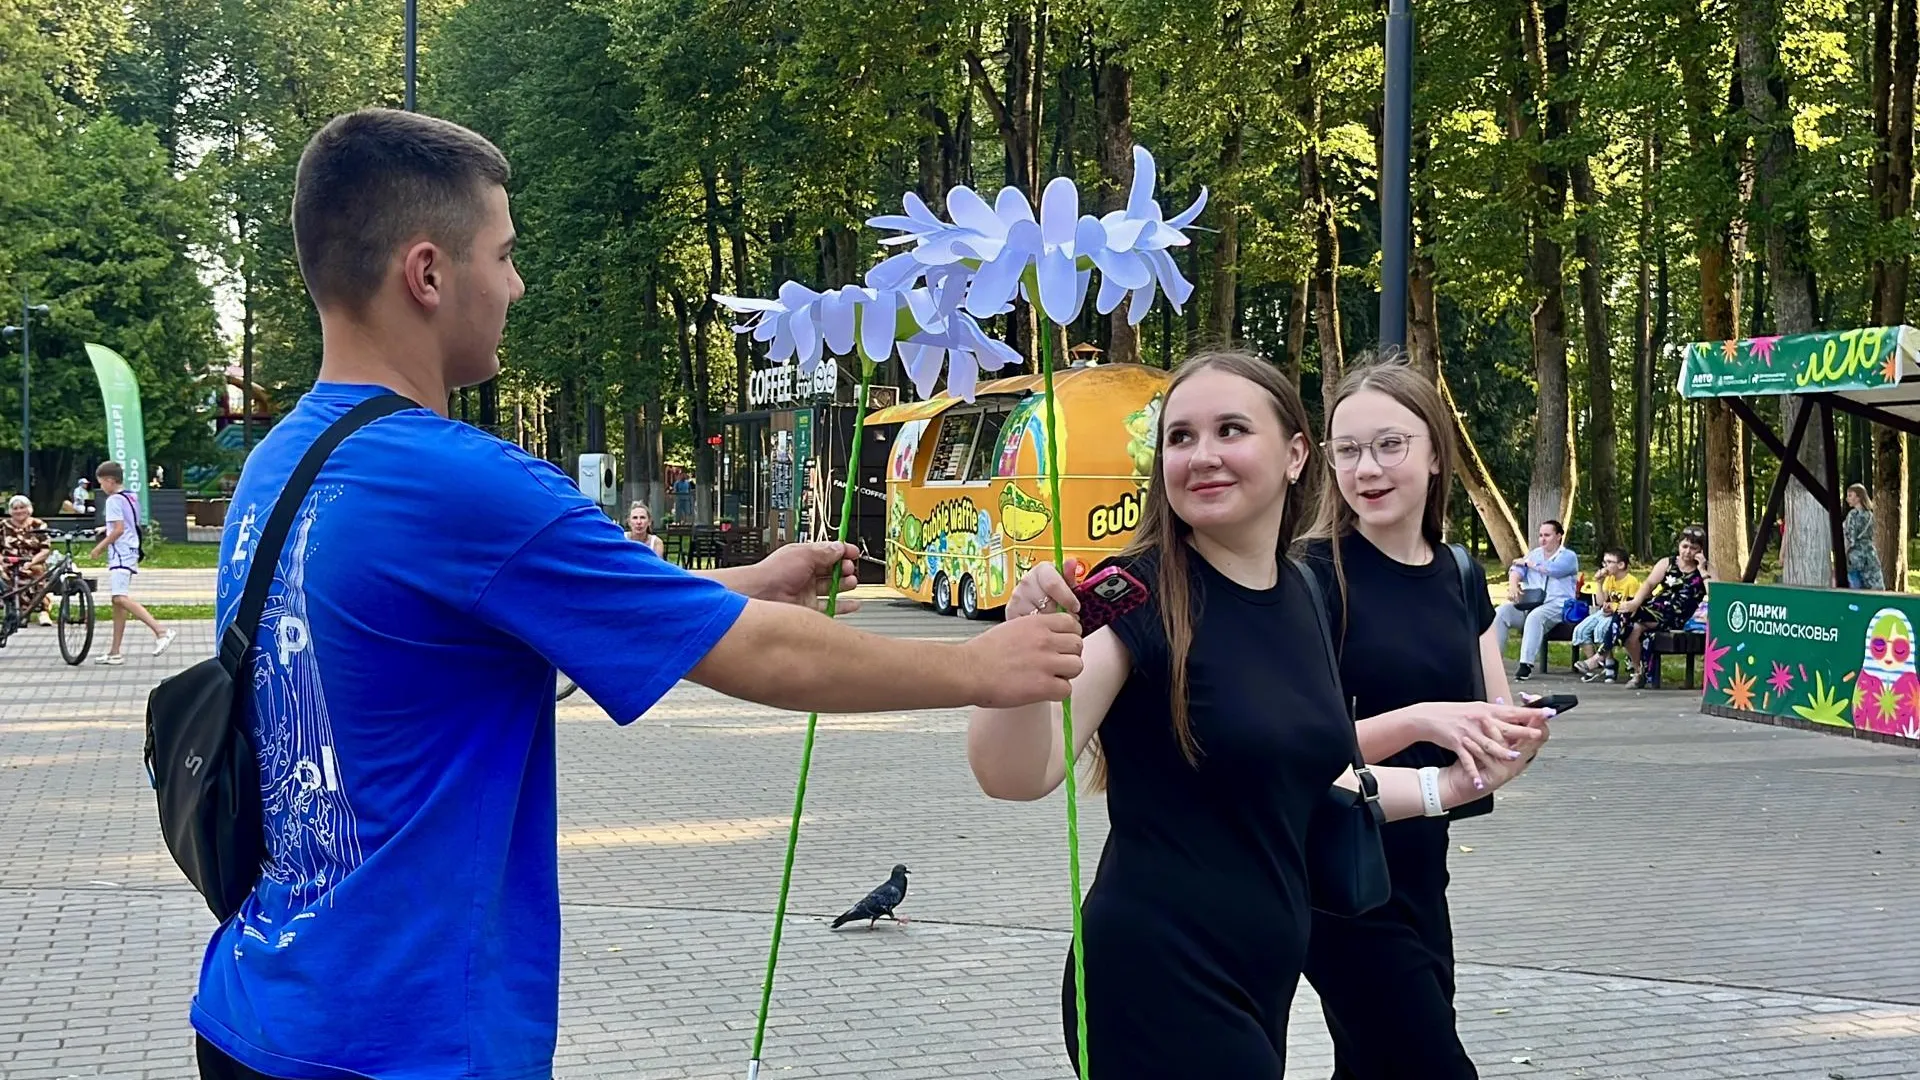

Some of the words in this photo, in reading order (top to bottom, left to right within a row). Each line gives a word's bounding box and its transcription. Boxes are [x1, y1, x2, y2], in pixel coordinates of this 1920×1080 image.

[748, 364, 792, 405] COFFEE
[833, 479, 859, 493] FAMY
[860, 487, 887, 500] COFFEE
[922, 500, 949, 550] Bubble
[949, 497, 978, 535] Waffle
[1749, 603, 1787, 620] ПАРКИ
[1748, 619, 1838, 642] ПОДМОСКОВЬЯ
